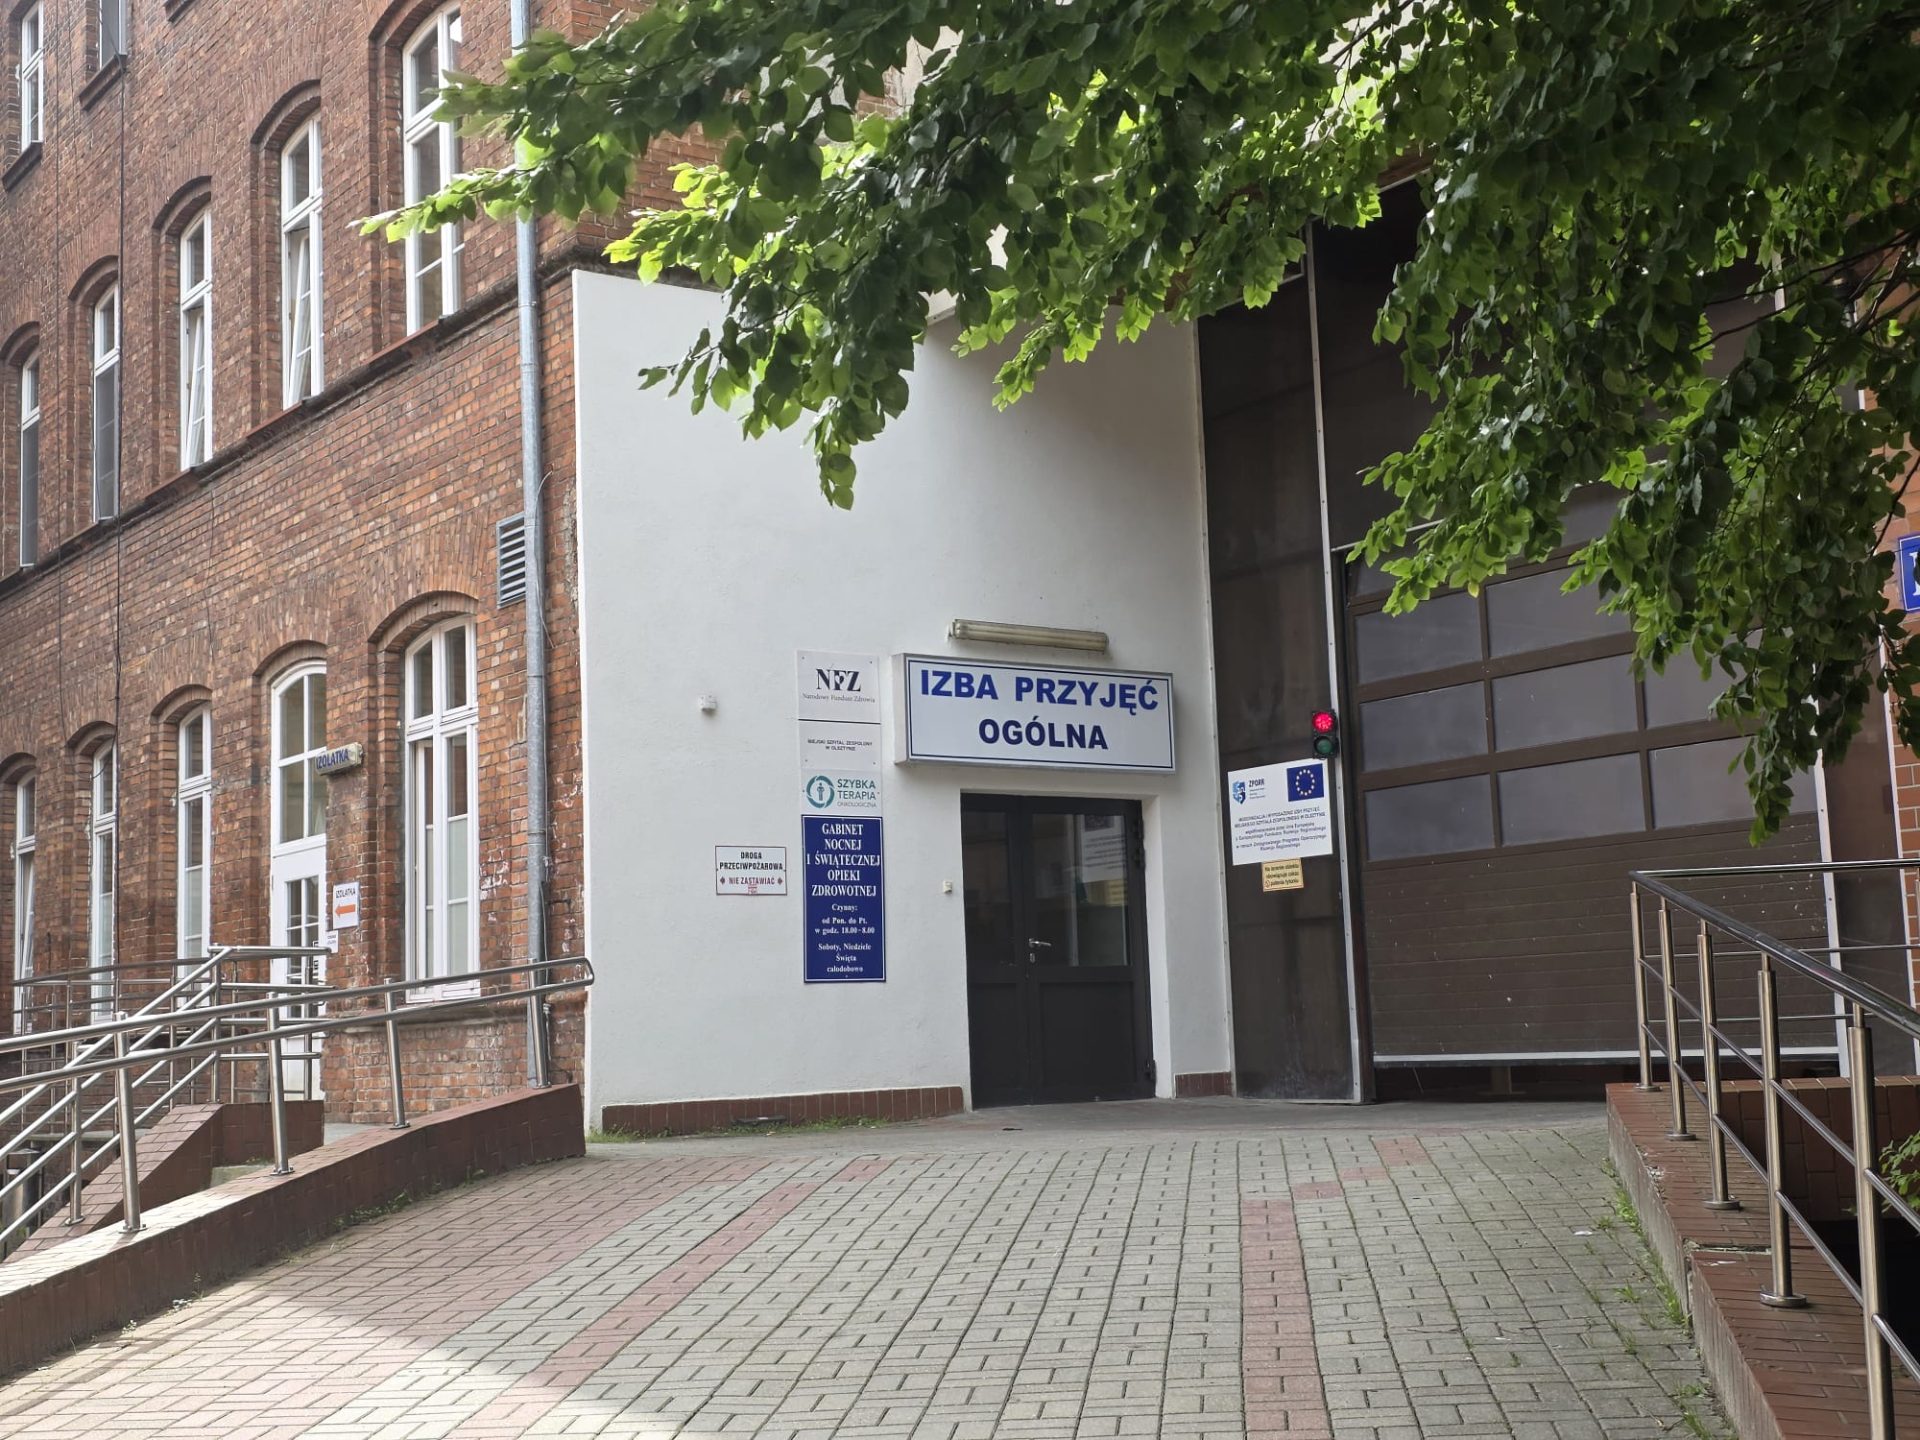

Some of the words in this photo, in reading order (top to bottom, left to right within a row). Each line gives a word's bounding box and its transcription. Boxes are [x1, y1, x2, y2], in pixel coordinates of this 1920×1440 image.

[816, 669, 861, 692] NFZ
[920, 669, 999, 700] IZBA
[1015, 676, 1158, 715] PRZYJĘĆ
[979, 716, 1108, 750] OGÓLNA
[316, 749, 349, 769] IZOLATKA
[837, 778, 876, 789] SZYBKA
[837, 790, 876, 800] TERAPIA
[822, 823, 864, 835] GABINET
[824, 839, 861, 850] NOCNEJ
[741, 851, 762, 859] DROGA
[806, 853, 811, 865] I
[814, 850, 880, 869] ŚWIĄTECZNEJ
[720, 862, 783, 870] PRZECIWPOŻAROWA
[728, 876, 739, 885] NIE
[827, 869, 860, 881] OPIEKI
[811, 884, 877, 897] ZDROWOTNEJ
[831, 903, 858, 912] Czynny:
[821, 917, 831, 925] od
[832, 917, 847, 925] Pon.
[848, 917, 857, 925] do
[858, 917, 868, 925] Pt.
[822, 927, 839, 935] godz.
[818, 943, 842, 952] Soboty,
[843, 943, 872, 951] Niedziele
[835, 952, 857, 963] Święta
